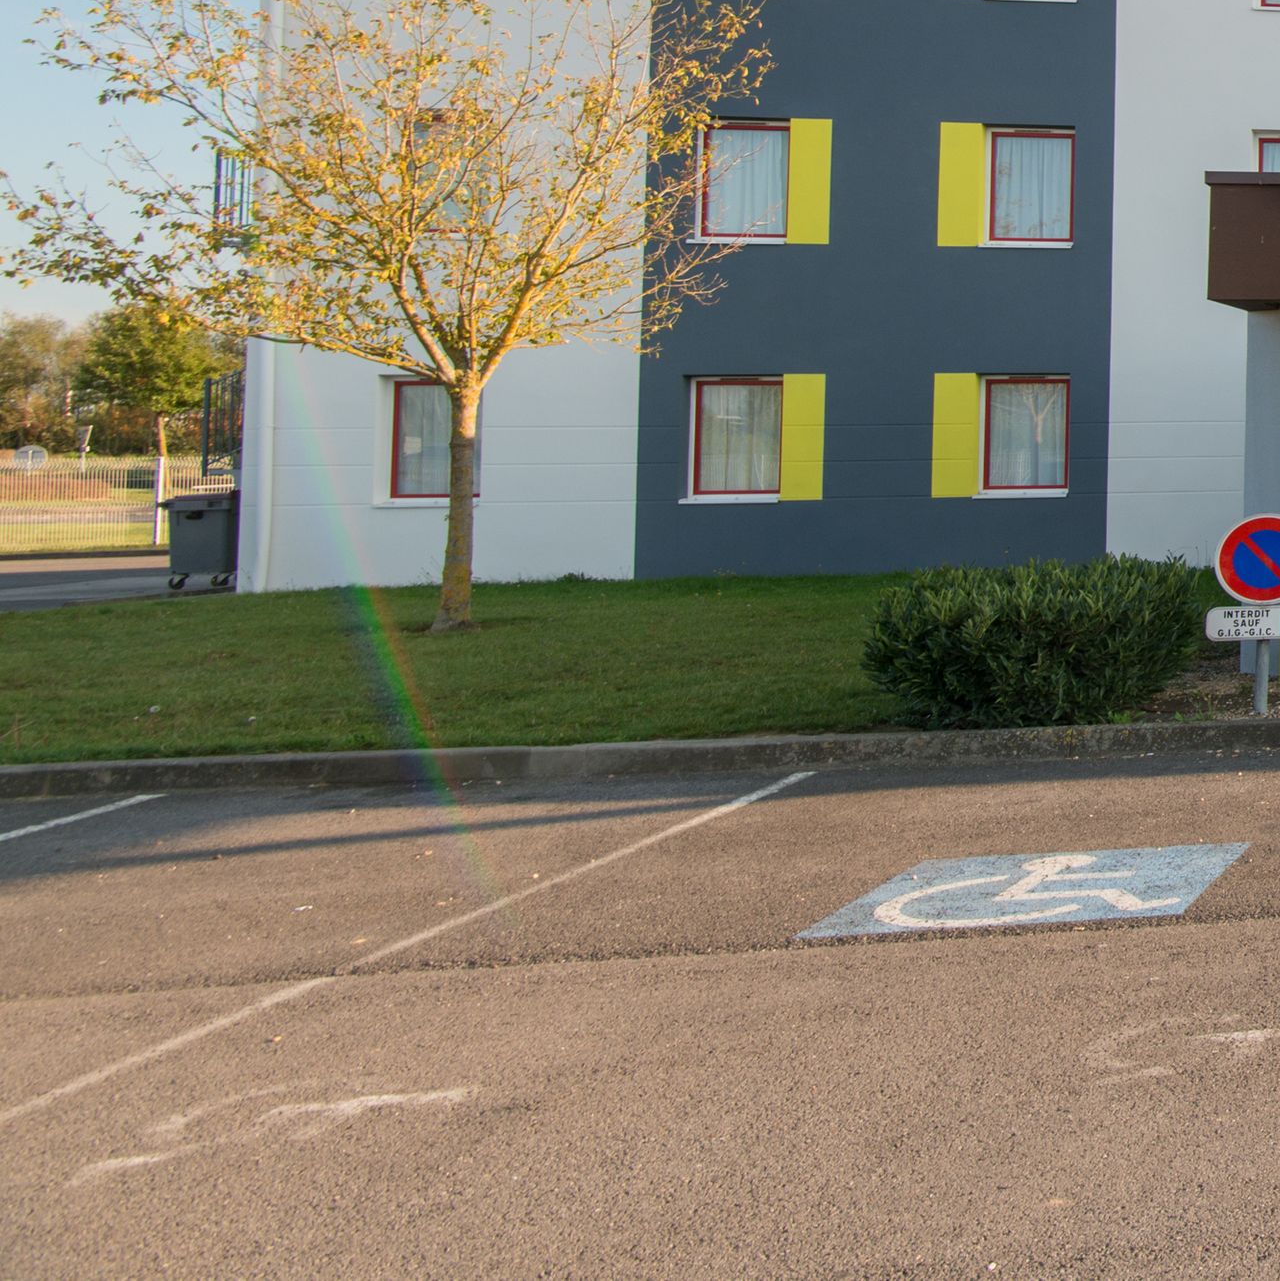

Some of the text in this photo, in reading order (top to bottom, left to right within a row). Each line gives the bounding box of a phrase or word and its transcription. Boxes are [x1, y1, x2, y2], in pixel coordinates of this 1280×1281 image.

[1223, 609, 1271, 618] INTERDIT
[1233, 619, 1261, 628] SAUF
[1217, 628, 1275, 637] G.I.G.-G.I.C.
